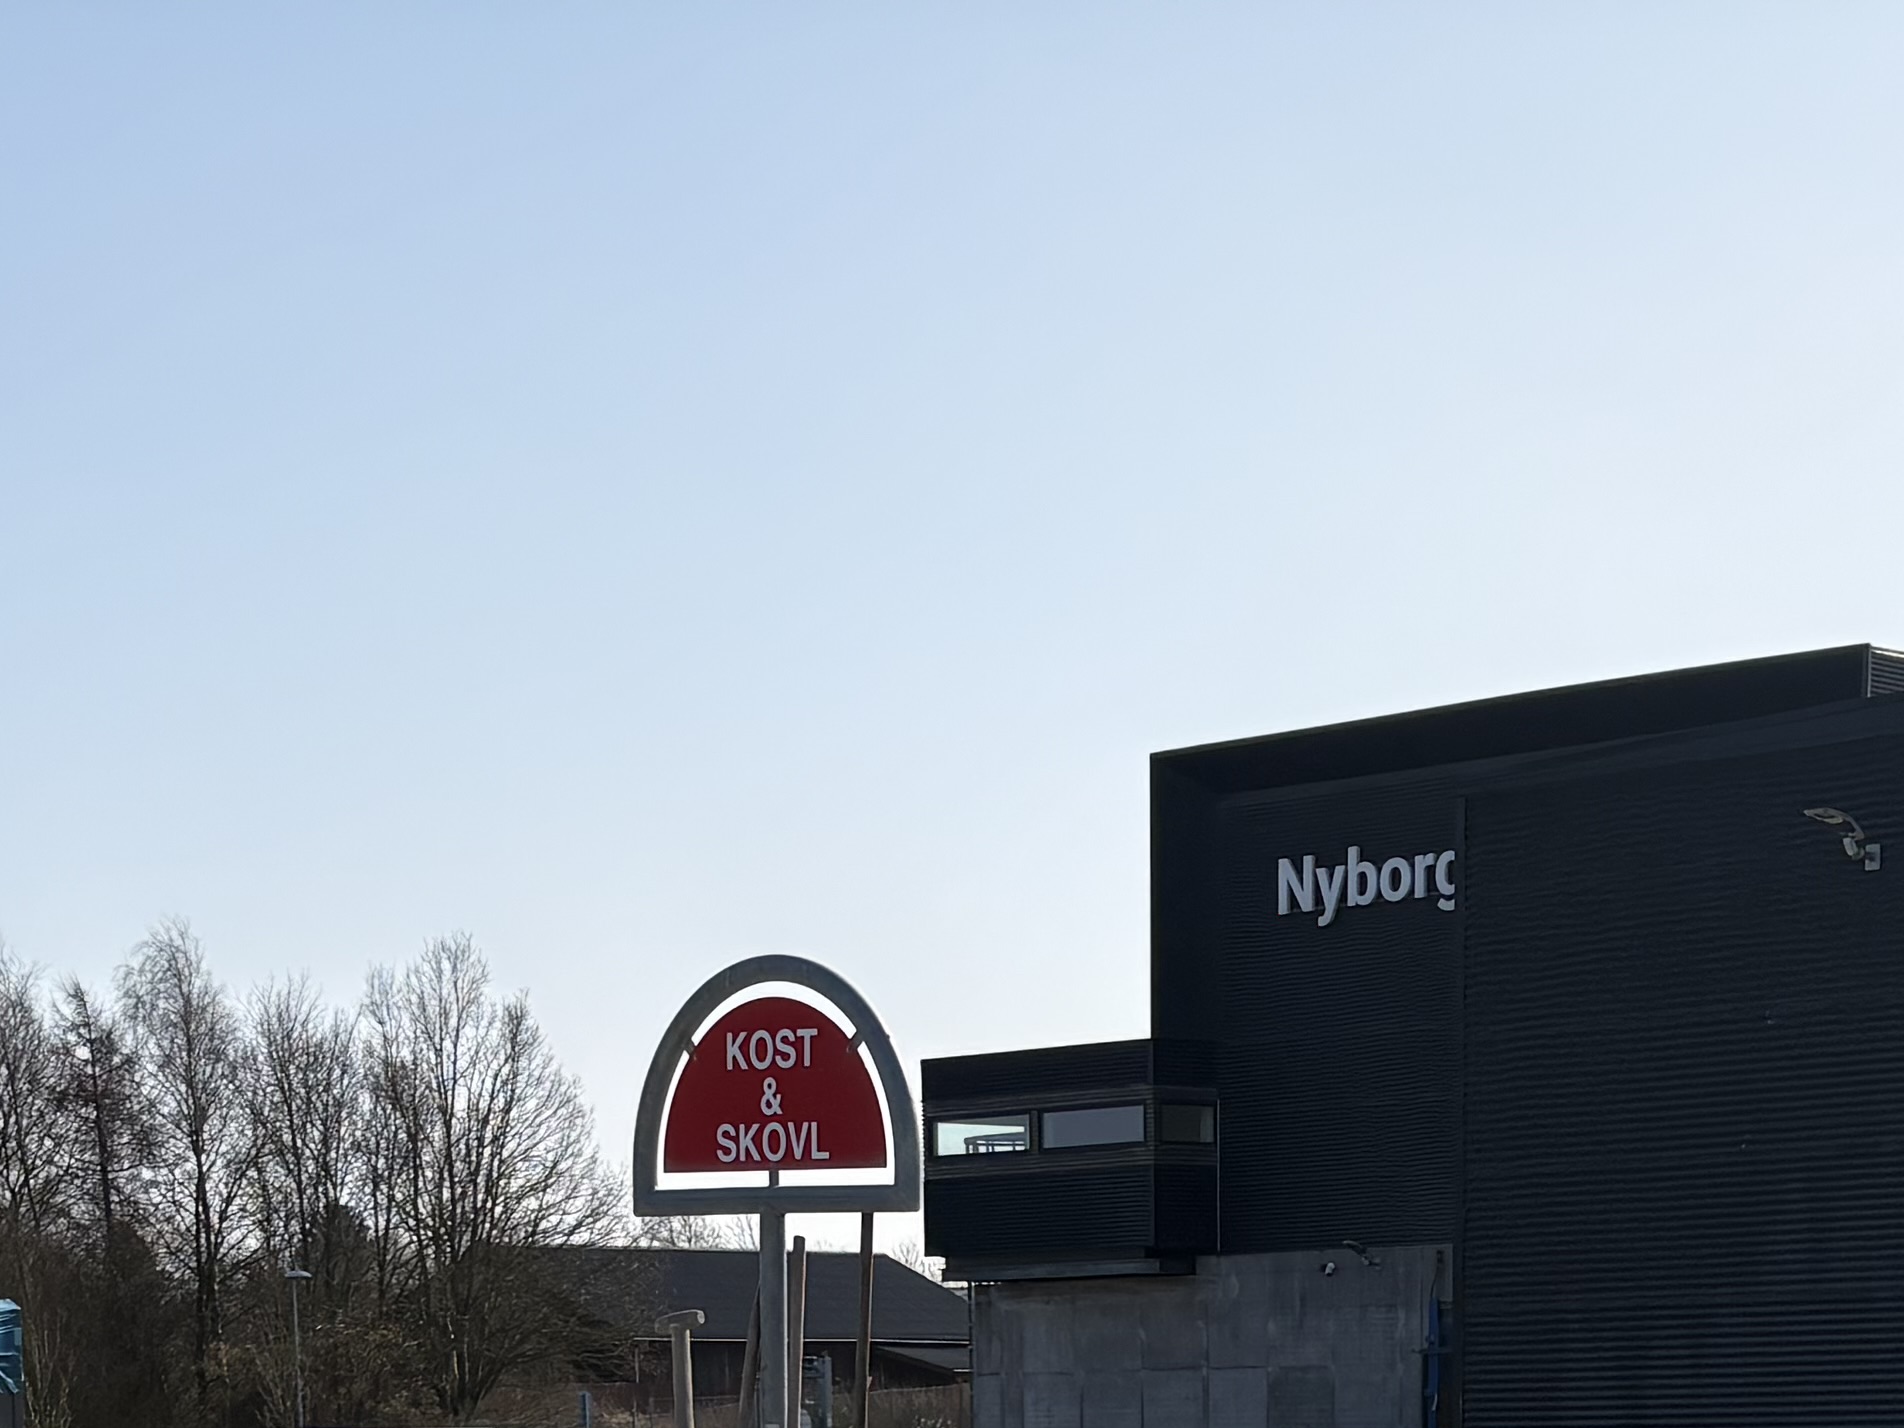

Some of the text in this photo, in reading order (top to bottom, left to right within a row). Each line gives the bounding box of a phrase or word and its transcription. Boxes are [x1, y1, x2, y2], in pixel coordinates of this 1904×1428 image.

[726, 1028, 818, 1071] KOST
[760, 1077, 783, 1116] &
[716, 1121, 830, 1163] SKOVL
